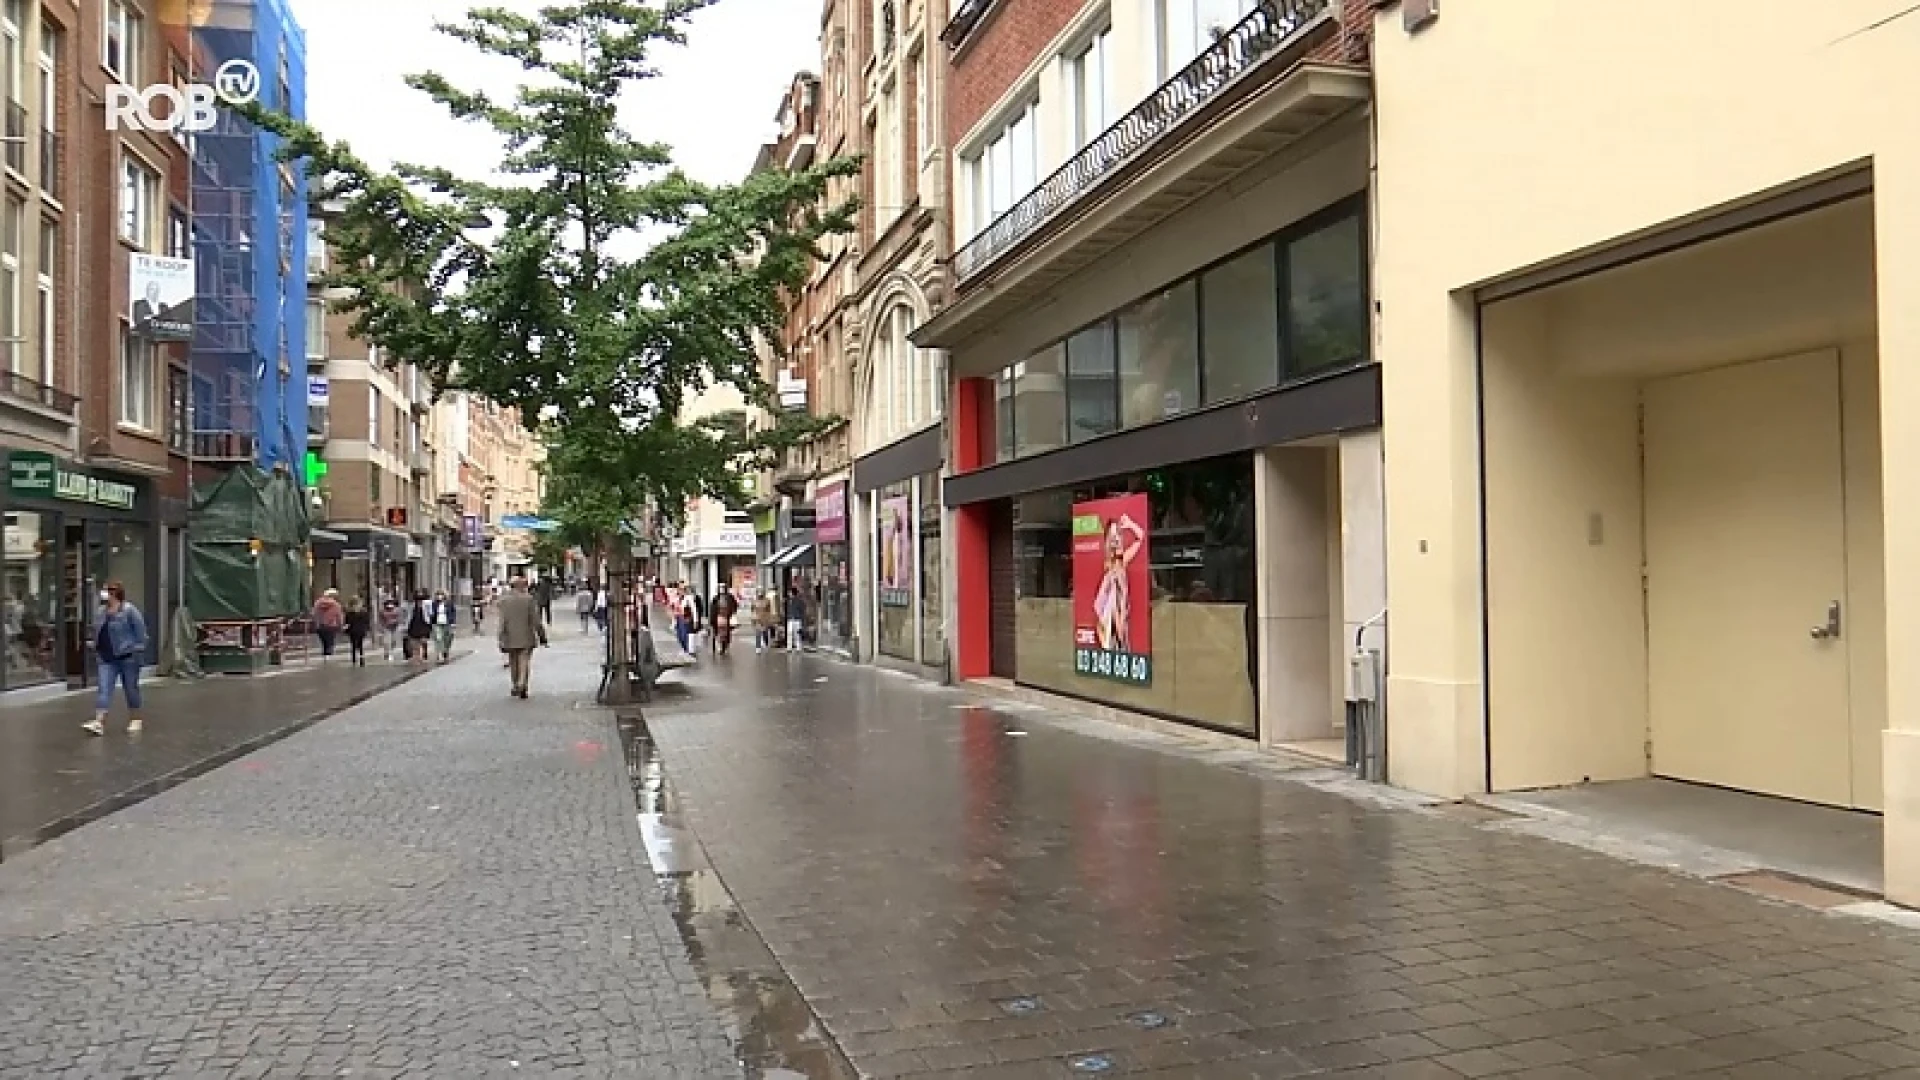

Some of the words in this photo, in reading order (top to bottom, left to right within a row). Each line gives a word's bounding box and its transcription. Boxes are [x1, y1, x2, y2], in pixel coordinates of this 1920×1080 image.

[1077, 649, 1091, 673] 03
[1091, 650, 1112, 676] 248
[1113, 654, 1129, 678] 68
[1130, 656, 1147, 680] 60
